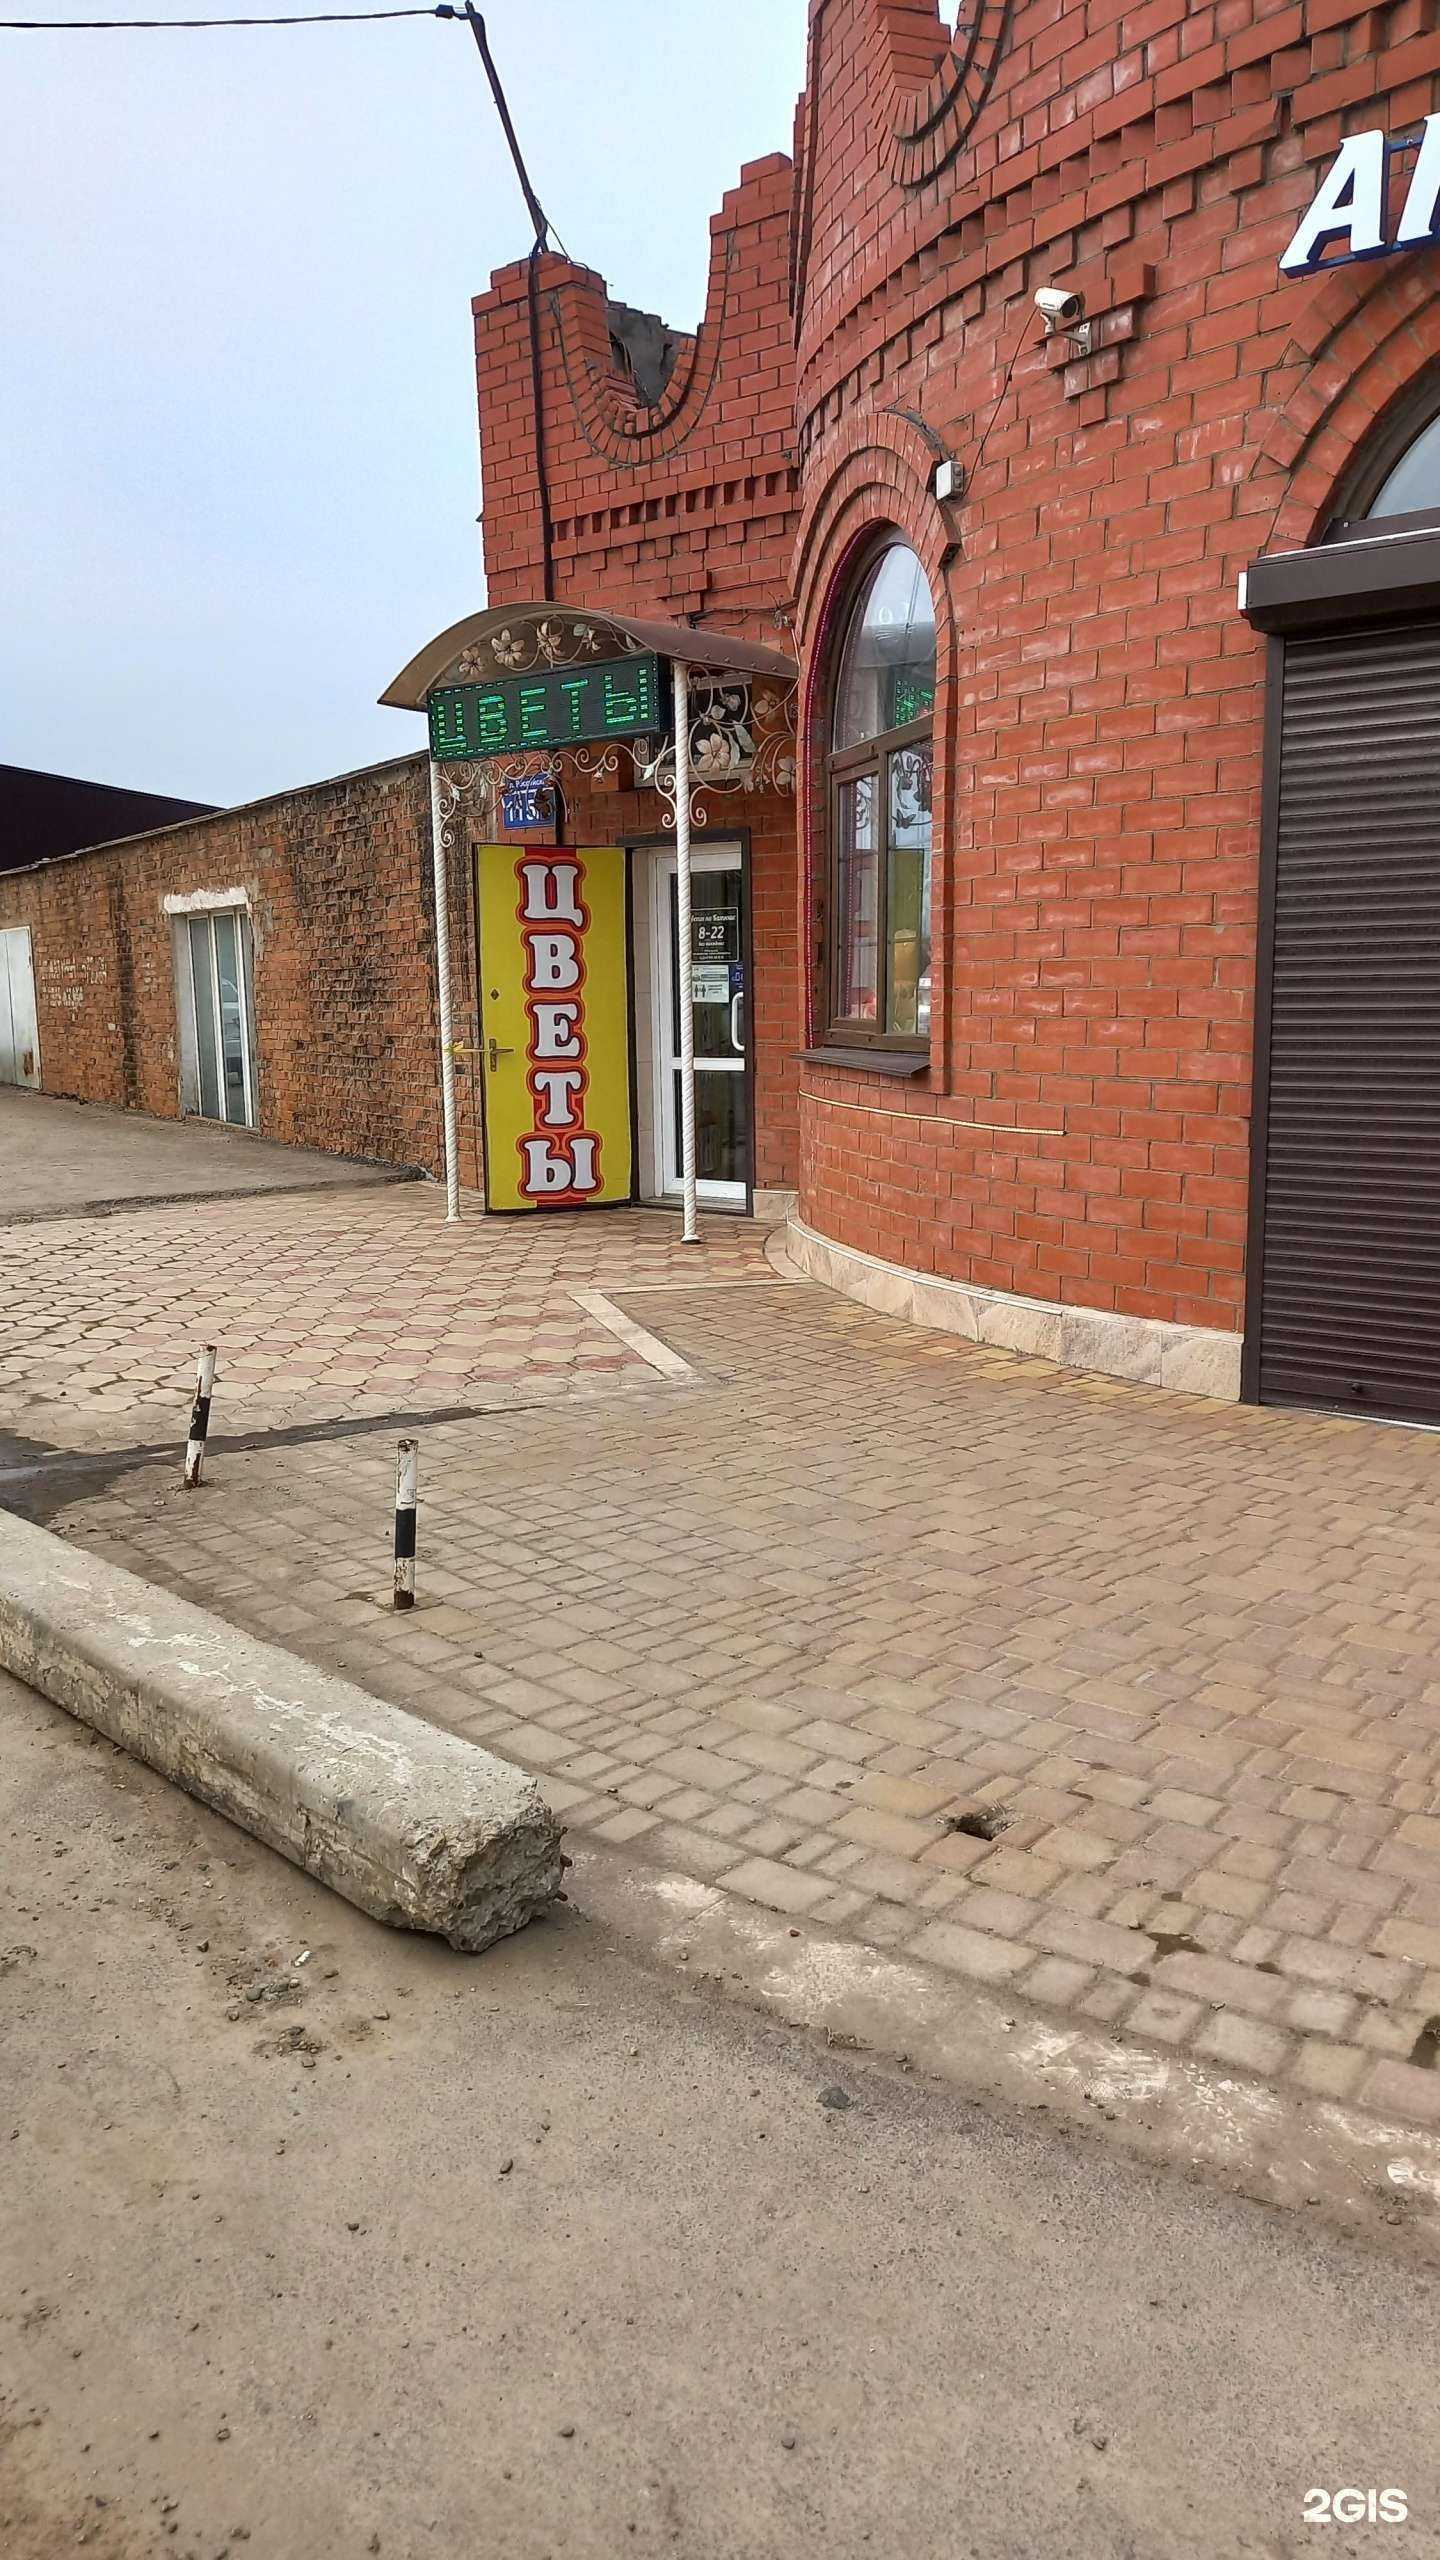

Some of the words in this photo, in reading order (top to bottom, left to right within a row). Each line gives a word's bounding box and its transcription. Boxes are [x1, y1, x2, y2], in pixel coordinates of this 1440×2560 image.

[436, 668, 649, 749] ЦВЕТЫ
[698, 925, 725, 939] 8-22
[522, 863, 597, 1193] ЦВЕТЫ
